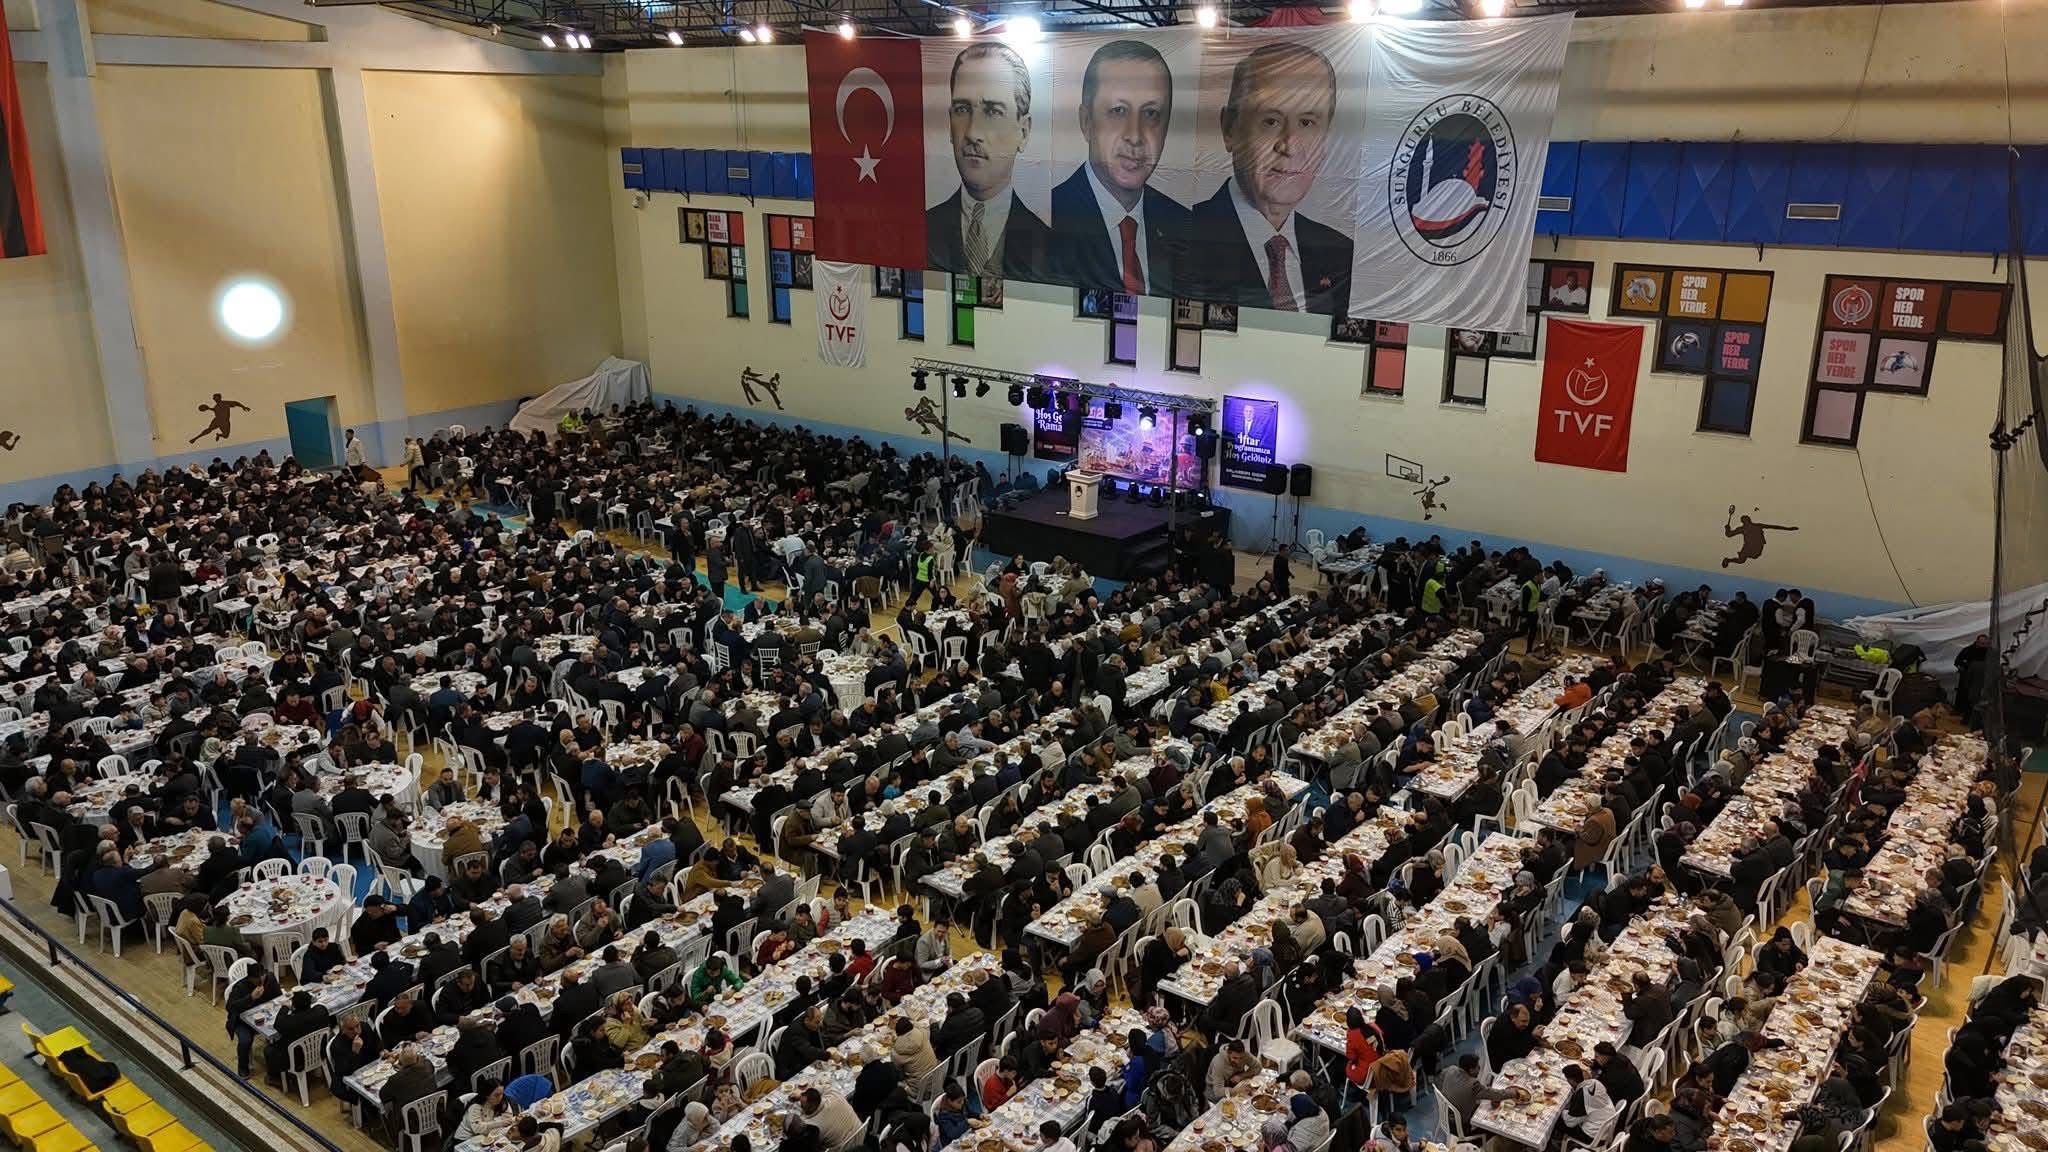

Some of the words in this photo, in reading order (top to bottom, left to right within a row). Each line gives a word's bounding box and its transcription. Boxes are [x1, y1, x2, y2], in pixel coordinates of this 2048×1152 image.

[1394, 104, 1448, 204] SUNGURLU
[1461, 100, 1511, 211] BELEDİYESİ
[1431, 251, 1457, 262] 1866
[1682, 275, 1708, 289] SPOR
[1680, 288, 1698, 300] HER
[1896, 287, 1925, 301] SPOR
[1680, 300, 1708, 313] YERDE
[1893, 300, 1914, 314] HER
[1892, 314, 1924, 328] YERDE
[824, 323, 856, 343] TVF
[1724, 331, 1751, 345] SPOR
[1722, 344, 1741, 356] HER
[1829, 338, 1857, 352] SPOR
[1722, 357, 1750, 370] YERDE
[1827, 352, 1847, 364] HER
[1826, 365, 1857, 378] YERDE
[1553, 409, 1614, 437] TVF
